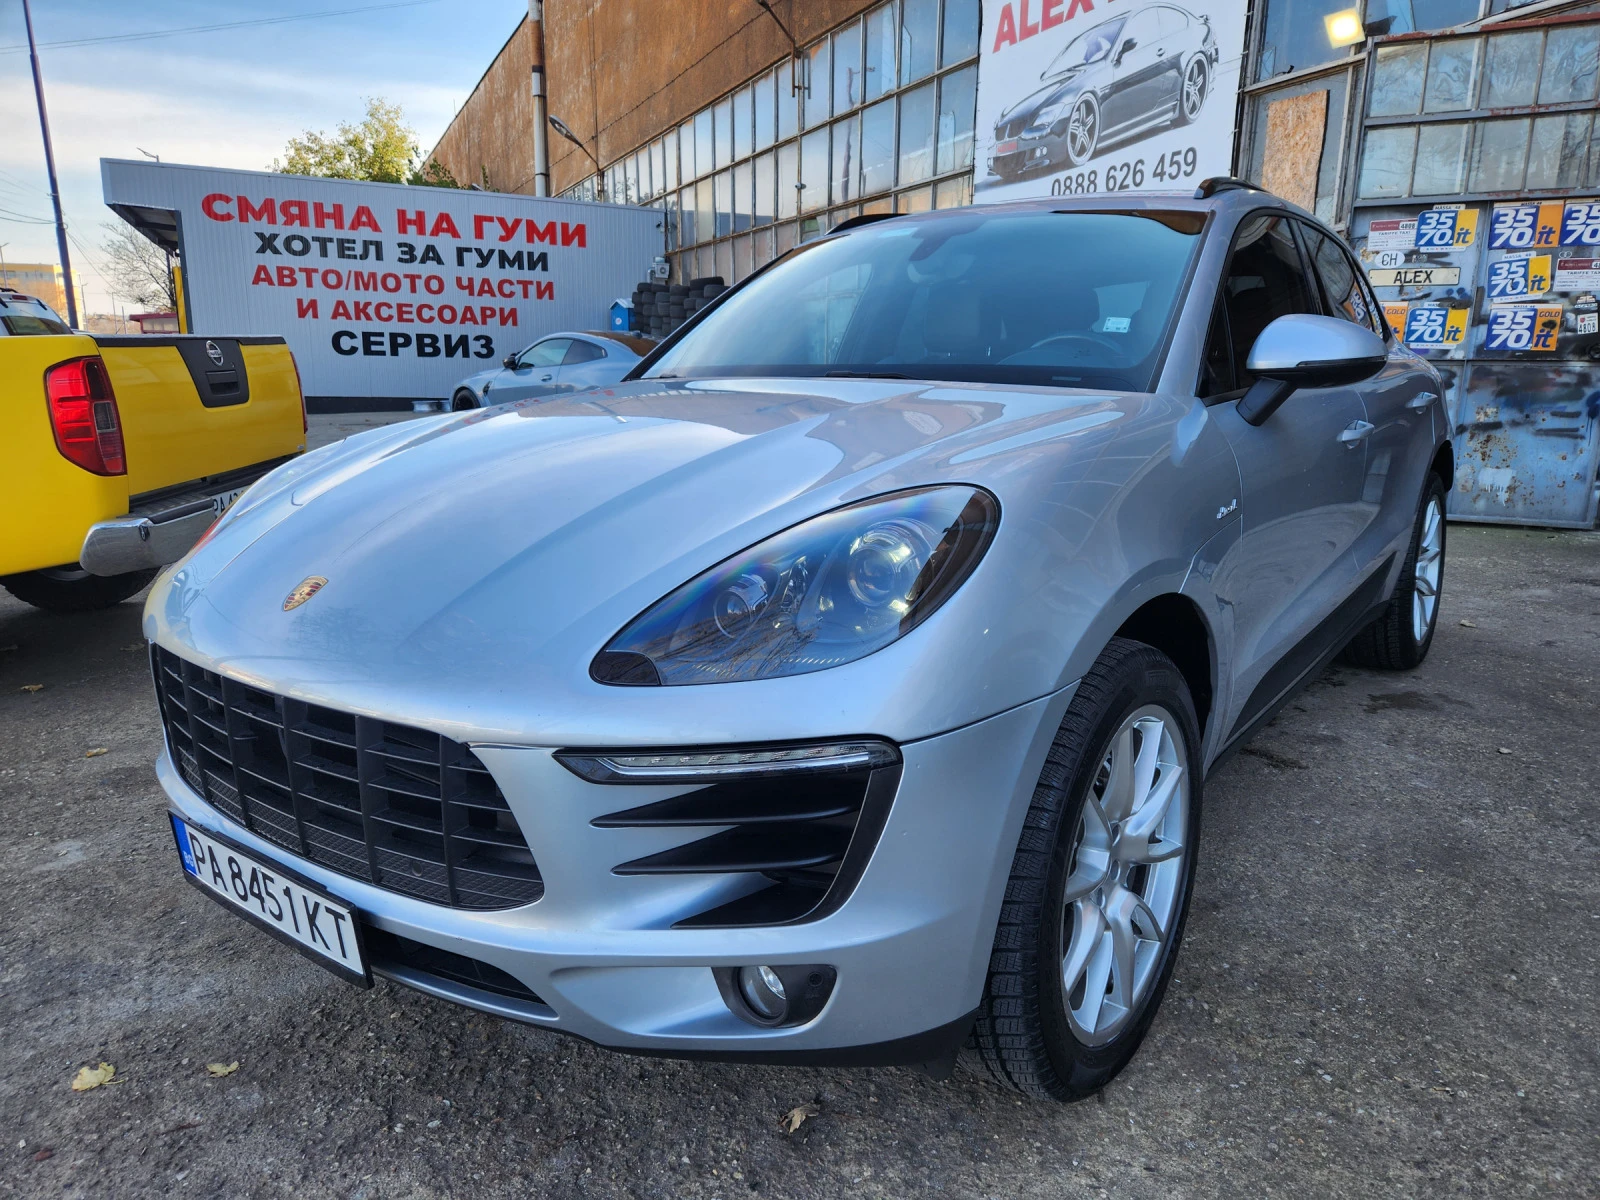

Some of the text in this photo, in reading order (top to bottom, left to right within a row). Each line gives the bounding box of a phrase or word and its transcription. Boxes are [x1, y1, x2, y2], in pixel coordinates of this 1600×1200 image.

[1051, 147, 1198, 196] 0888 626 459
[201, 193, 587, 248] СМЯНА НА ГУМИ
[1421, 212, 1456, 229] 35
[1494, 207, 1536, 229] 35
[254, 231, 549, 272] ХОТЕЛ ЗА ГУМИ
[251, 264, 555, 301] АВТО/МОТО ЧАСТИ
[1393, 270, 1434, 284] ALEX
[1491, 260, 1527, 280] 35
[296, 298, 518, 327] И АКСЕСОАРИ
[1411, 310, 1446, 326] 35
[1491, 311, 1534, 330] 35
[331, 330, 495, 359] СЕРВИЗ
